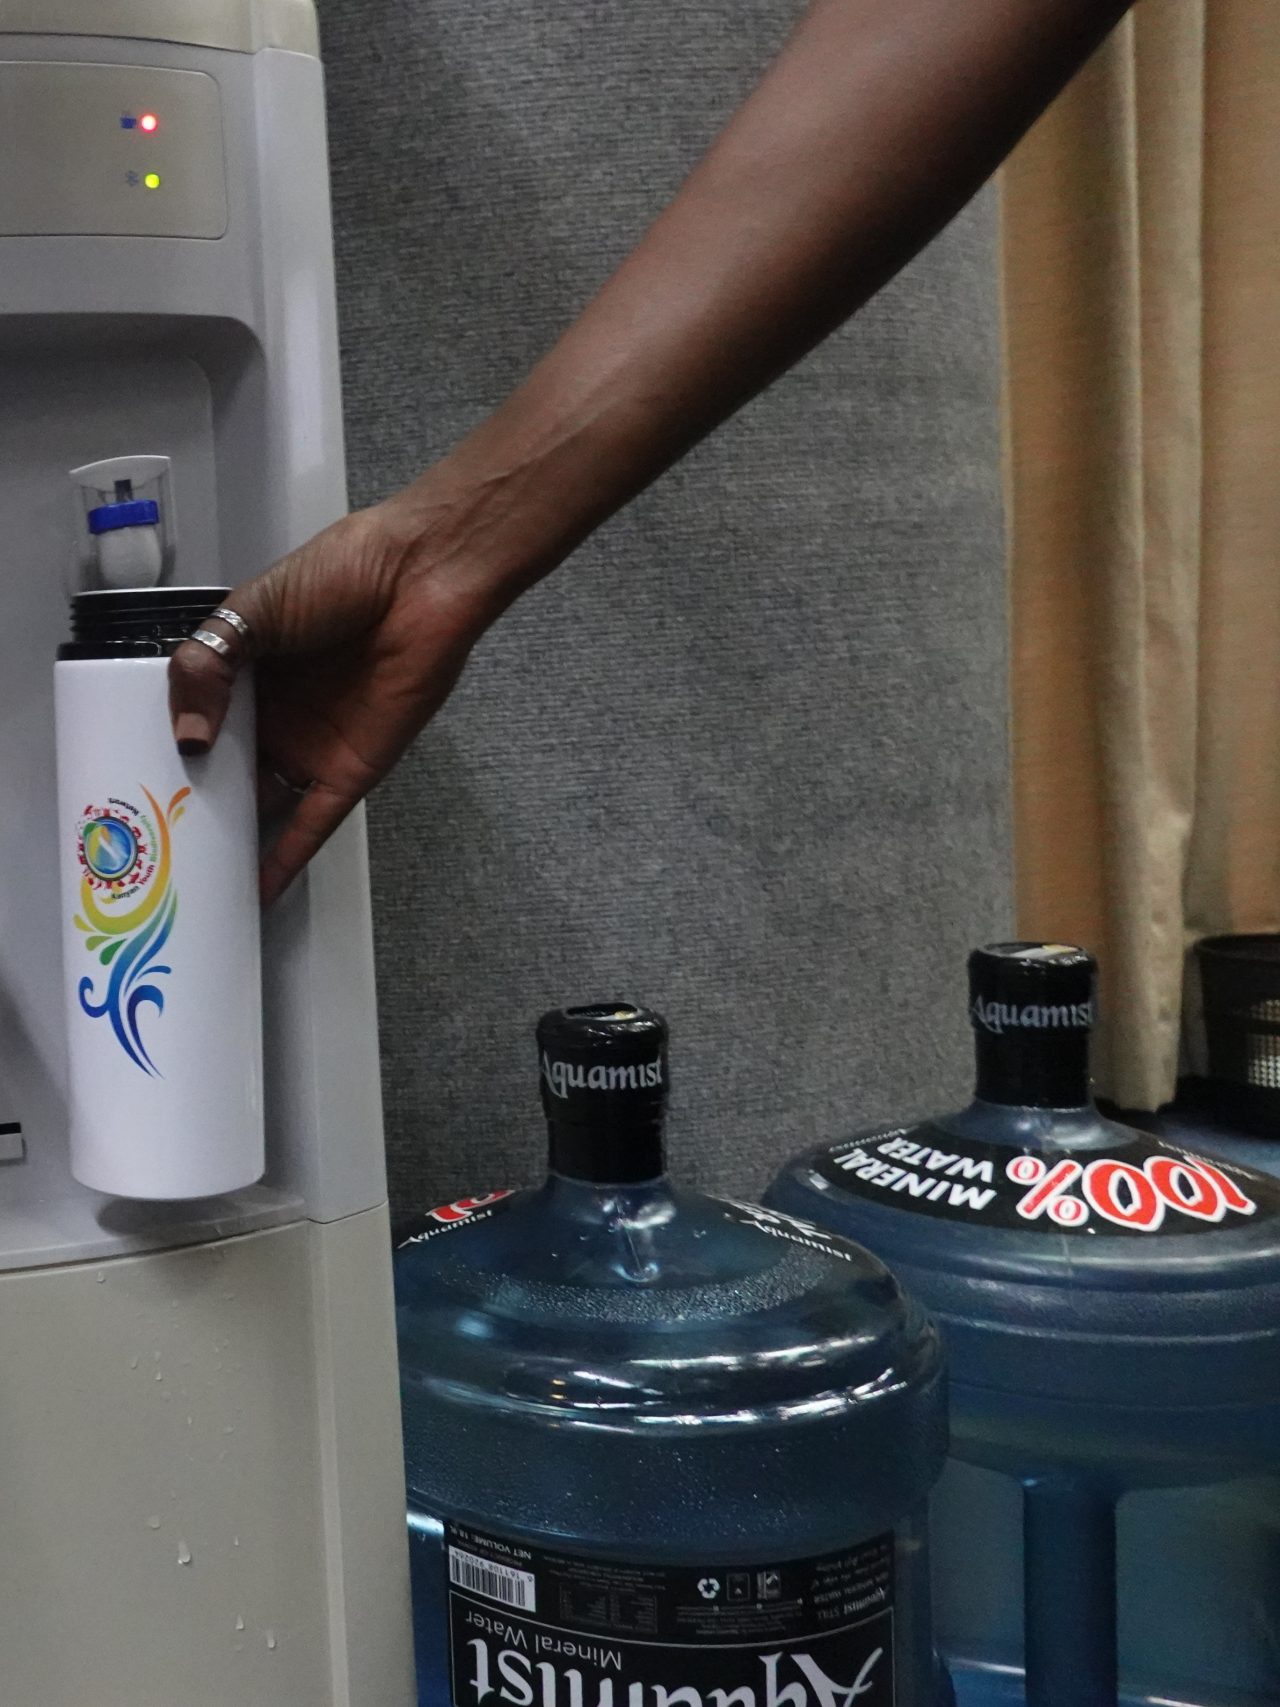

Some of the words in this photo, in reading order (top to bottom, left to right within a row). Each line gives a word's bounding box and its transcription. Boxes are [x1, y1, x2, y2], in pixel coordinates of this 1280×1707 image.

[832, 1146, 998, 1210] MINERAL
[877, 1136, 994, 1182] WATER
[1005, 1154, 1258, 1232] 100%
[514, 1549, 532, 1560] NET
[466, 1610, 528, 1650] Water
[536, 1633, 622, 1671] Mineral
